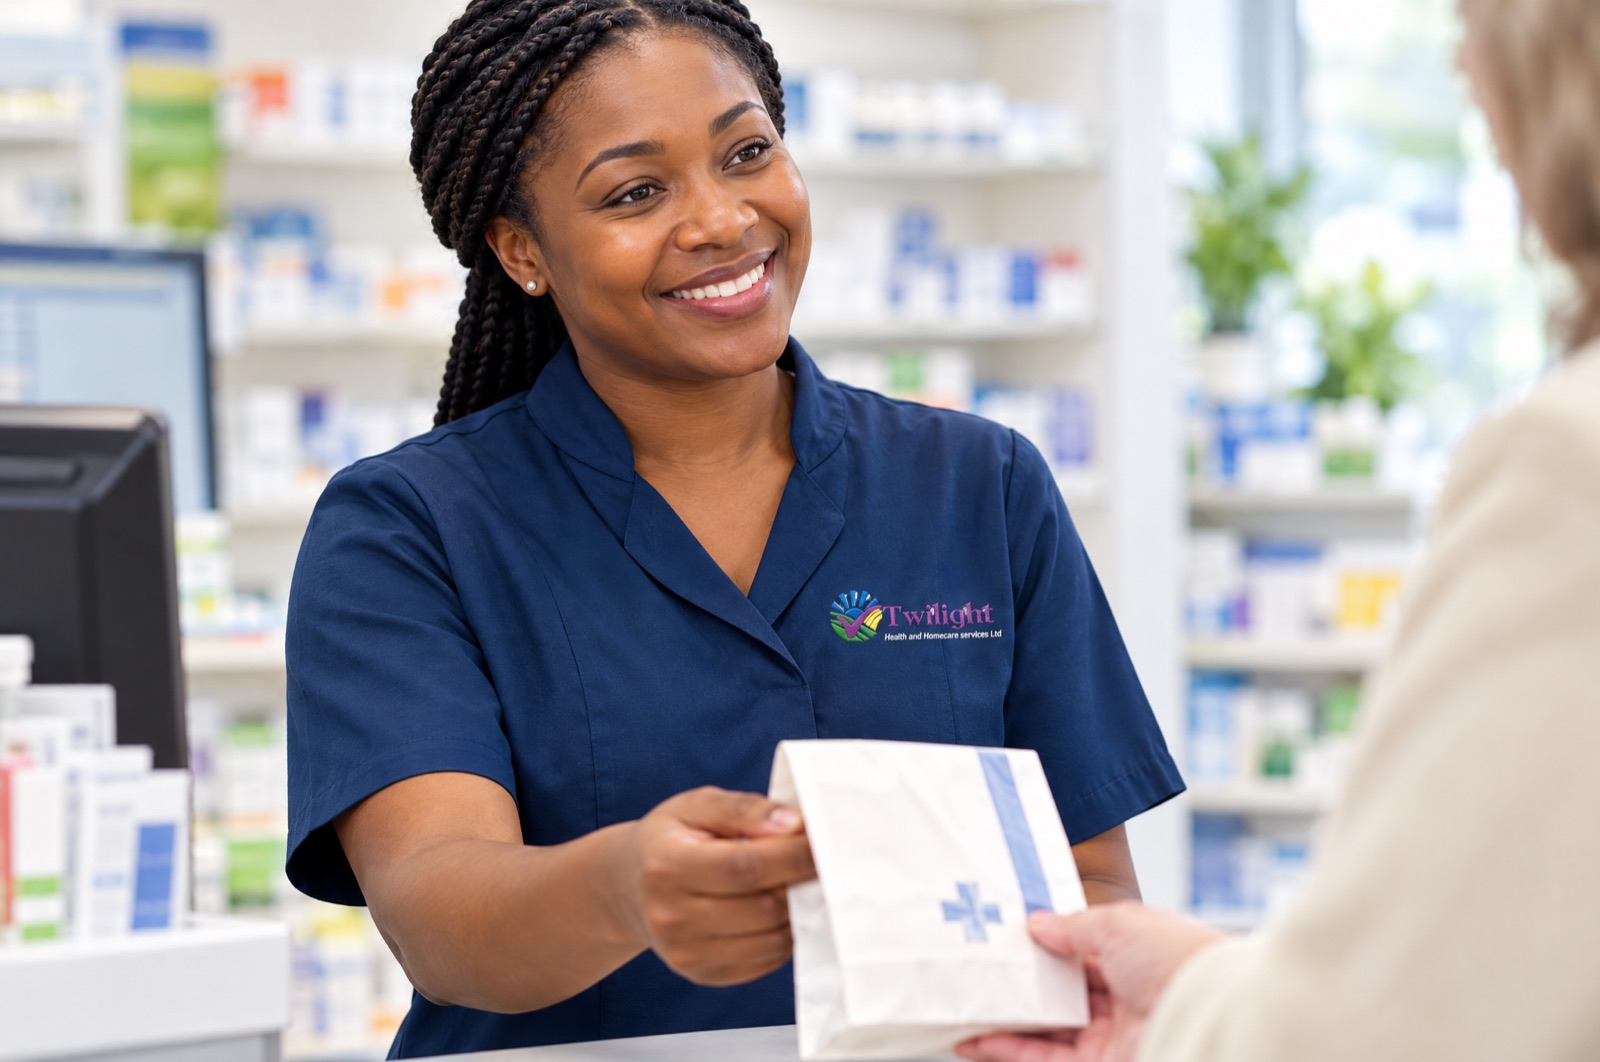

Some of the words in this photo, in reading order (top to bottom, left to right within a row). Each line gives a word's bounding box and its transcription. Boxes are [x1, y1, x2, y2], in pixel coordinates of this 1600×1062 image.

[883, 601, 994, 629] Twilight
[884, 632, 907, 641] Health
[908, 632, 922, 640] and
[923, 631, 959, 640] Homecare
[960, 630, 989, 639] services
[990, 629, 1002, 638] Ltd
